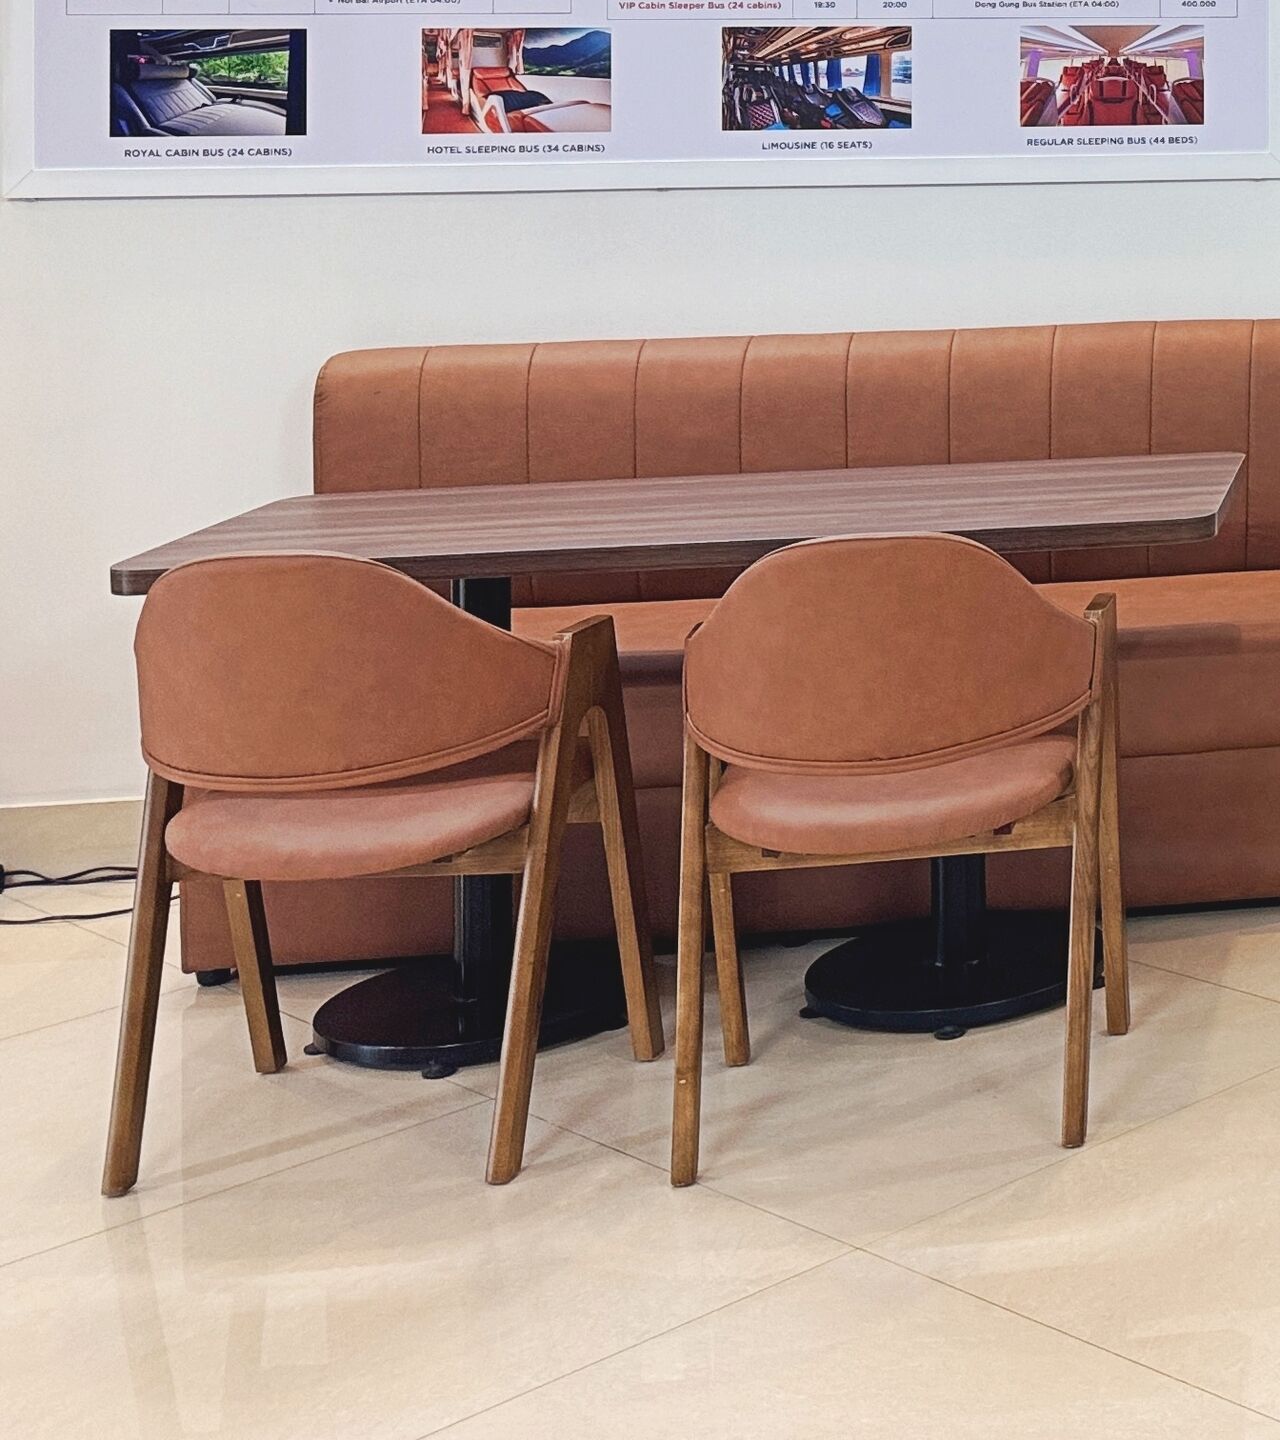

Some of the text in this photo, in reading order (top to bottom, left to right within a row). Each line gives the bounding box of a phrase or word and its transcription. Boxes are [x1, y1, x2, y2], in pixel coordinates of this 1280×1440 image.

[762, 141, 817, 150] LIMOUSINE
[837, 141, 872, 149] SEATS)
[1026, 138, 1074, 146] REGULAR
[1076, 137, 1124, 145] SLEEPING
[1148, 136, 1165, 145] (44
[1168, 136, 1198, 144] BEDS)
[124, 149, 162, 157] ROYAL
[165, 149, 199, 157] CABIN
[202, 148, 224, 157] BUS
[247, 148, 292, 156] CABINS)
[427, 144, 605, 154] HOTEL SLEEPING BUS (34 CABINS)
